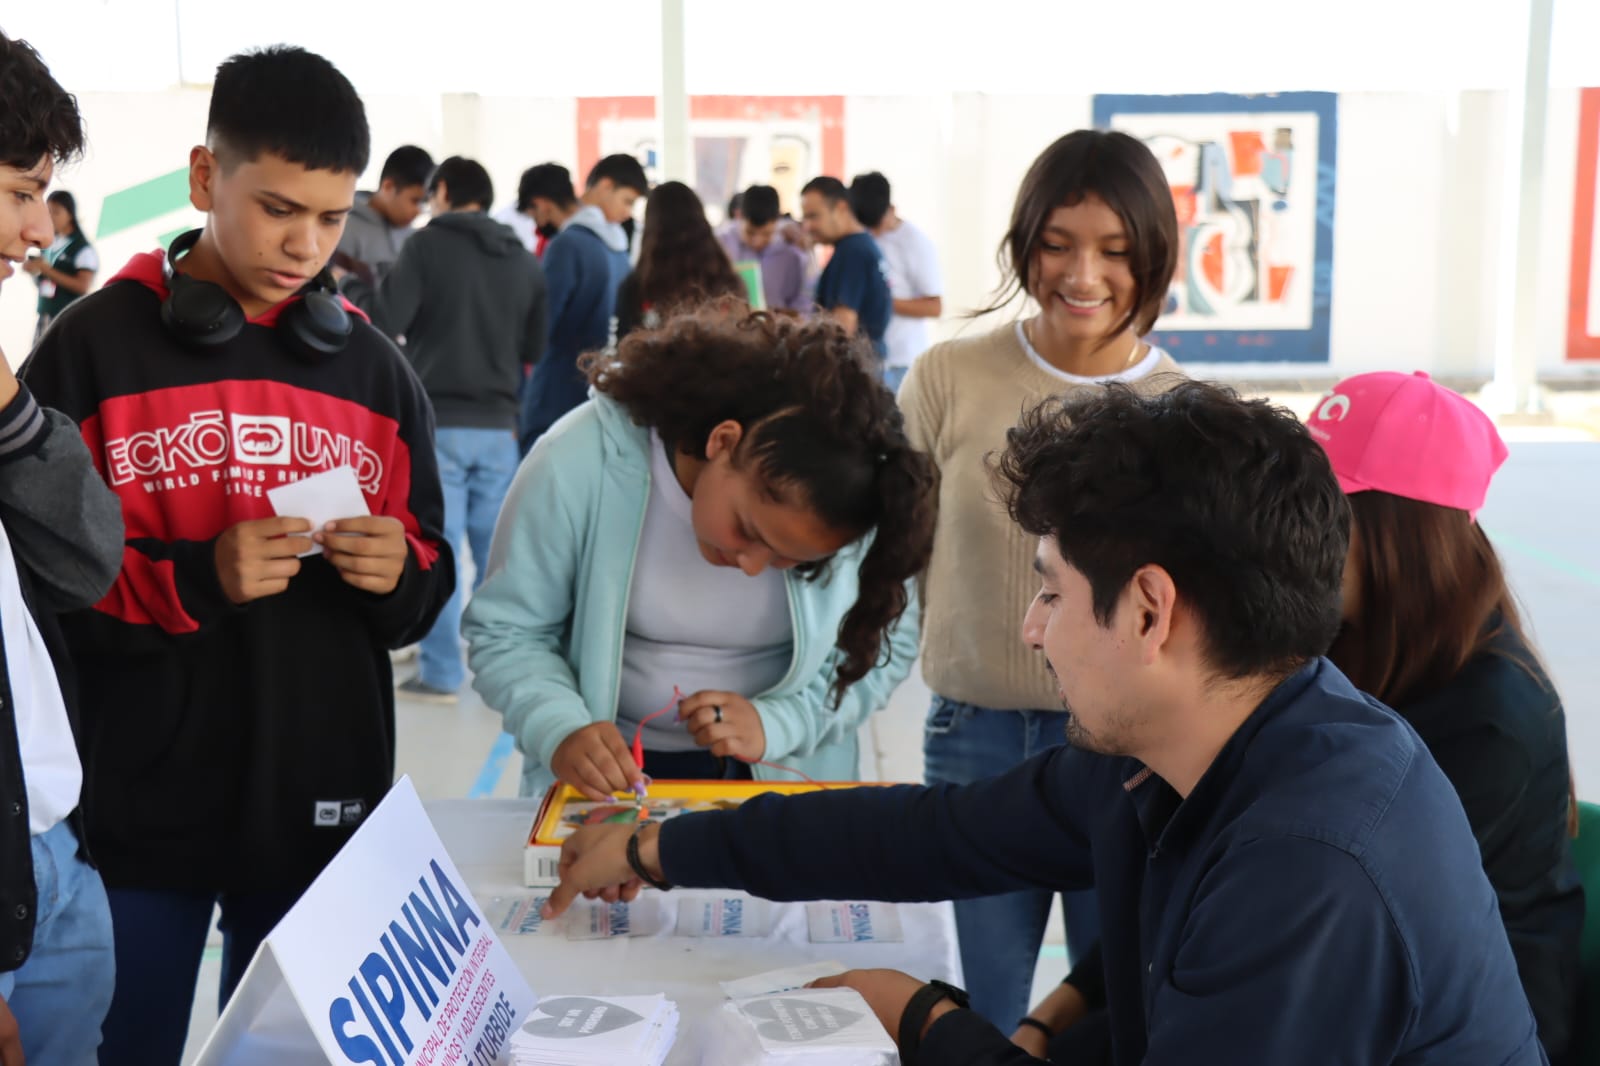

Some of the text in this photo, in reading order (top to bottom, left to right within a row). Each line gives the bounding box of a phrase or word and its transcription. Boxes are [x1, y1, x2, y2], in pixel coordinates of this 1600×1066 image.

[143, 473, 200, 494] WORLD
[722, 899, 743, 936] SIPINNA
[850, 904, 875, 942] SIPINNA
[329, 858, 481, 1066] SIPINNA
[468, 931, 494, 976] INTEGRAL
[444, 964, 476, 1022] PROTECCIÓN
[460, 967, 496, 1037] ADOLESCENTES
[437, 1013, 452, 1037] DE
[456, 1030, 466, 1046] Y
[473, 989, 517, 1066] ITURBIDE
